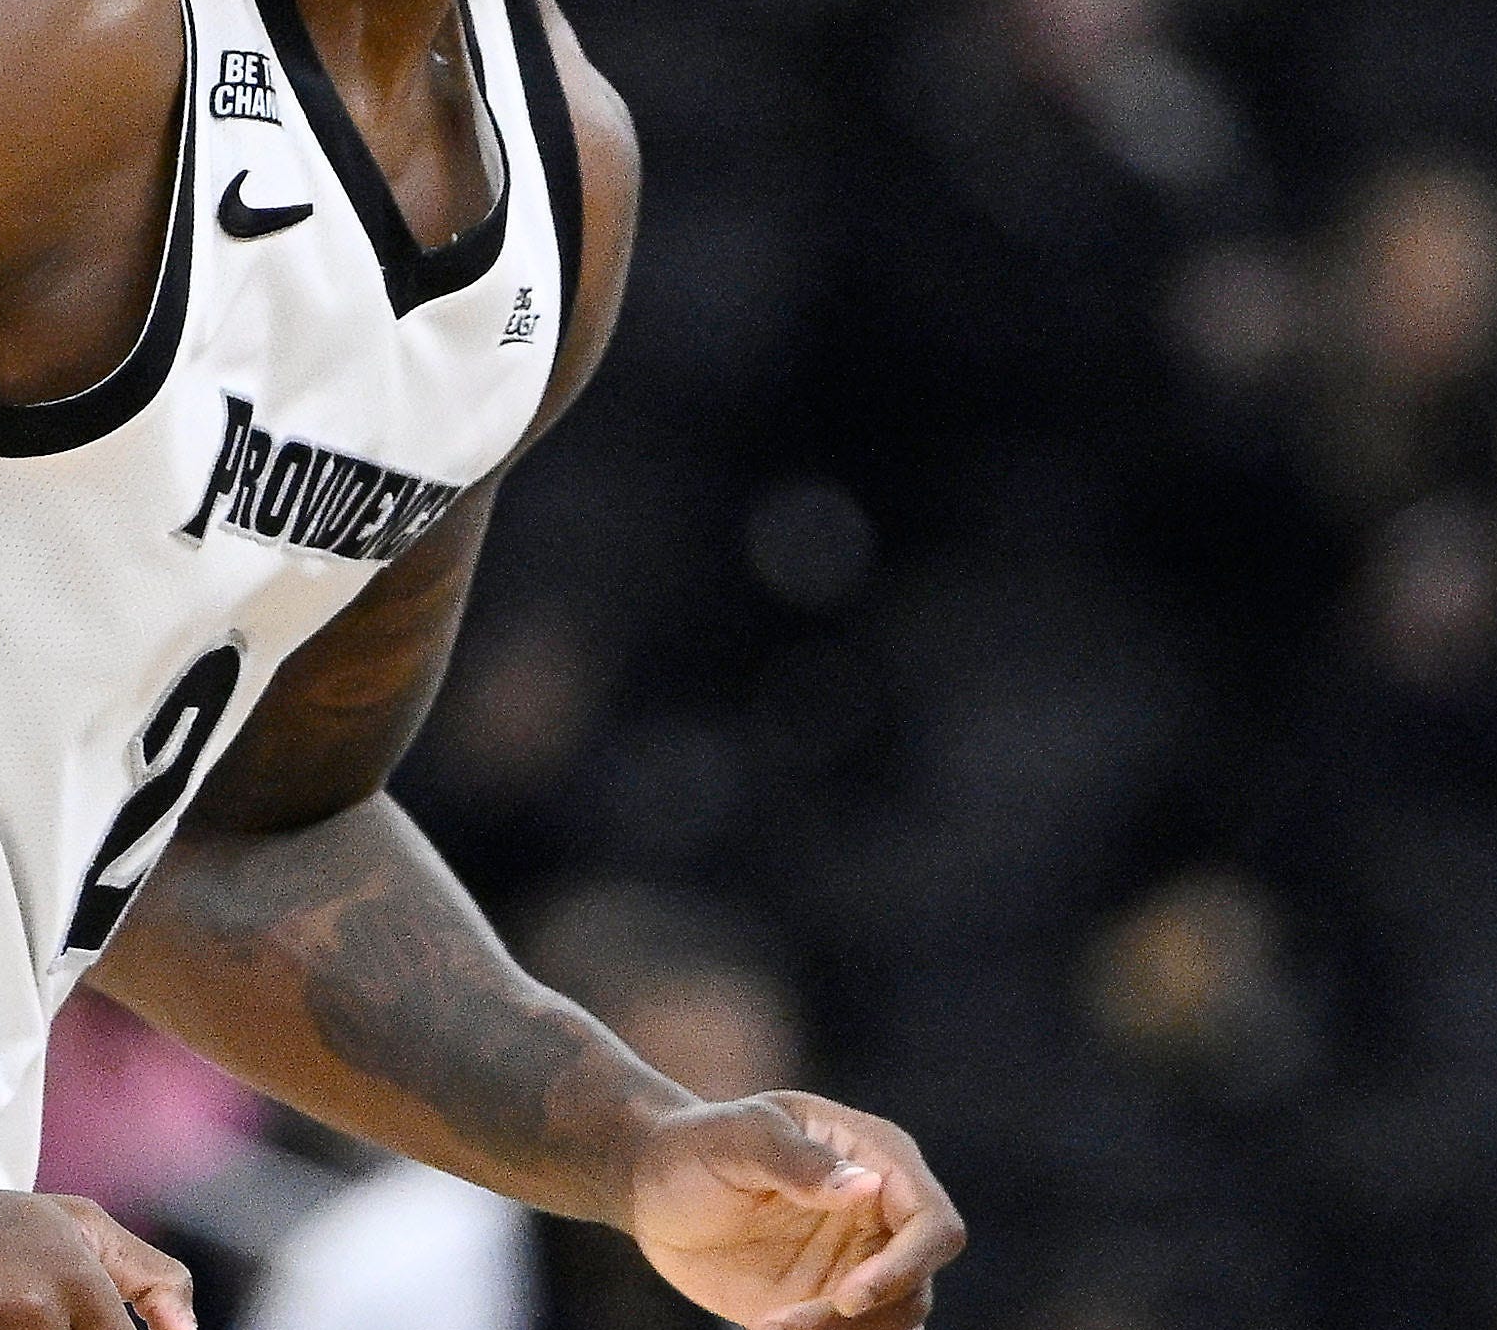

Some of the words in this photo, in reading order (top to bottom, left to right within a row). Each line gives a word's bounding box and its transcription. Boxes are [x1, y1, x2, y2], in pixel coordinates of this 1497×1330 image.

[225, 53, 259, 85] BE
[214, 84, 278, 120] CHAN
[54, 636, 245, 961] 2
